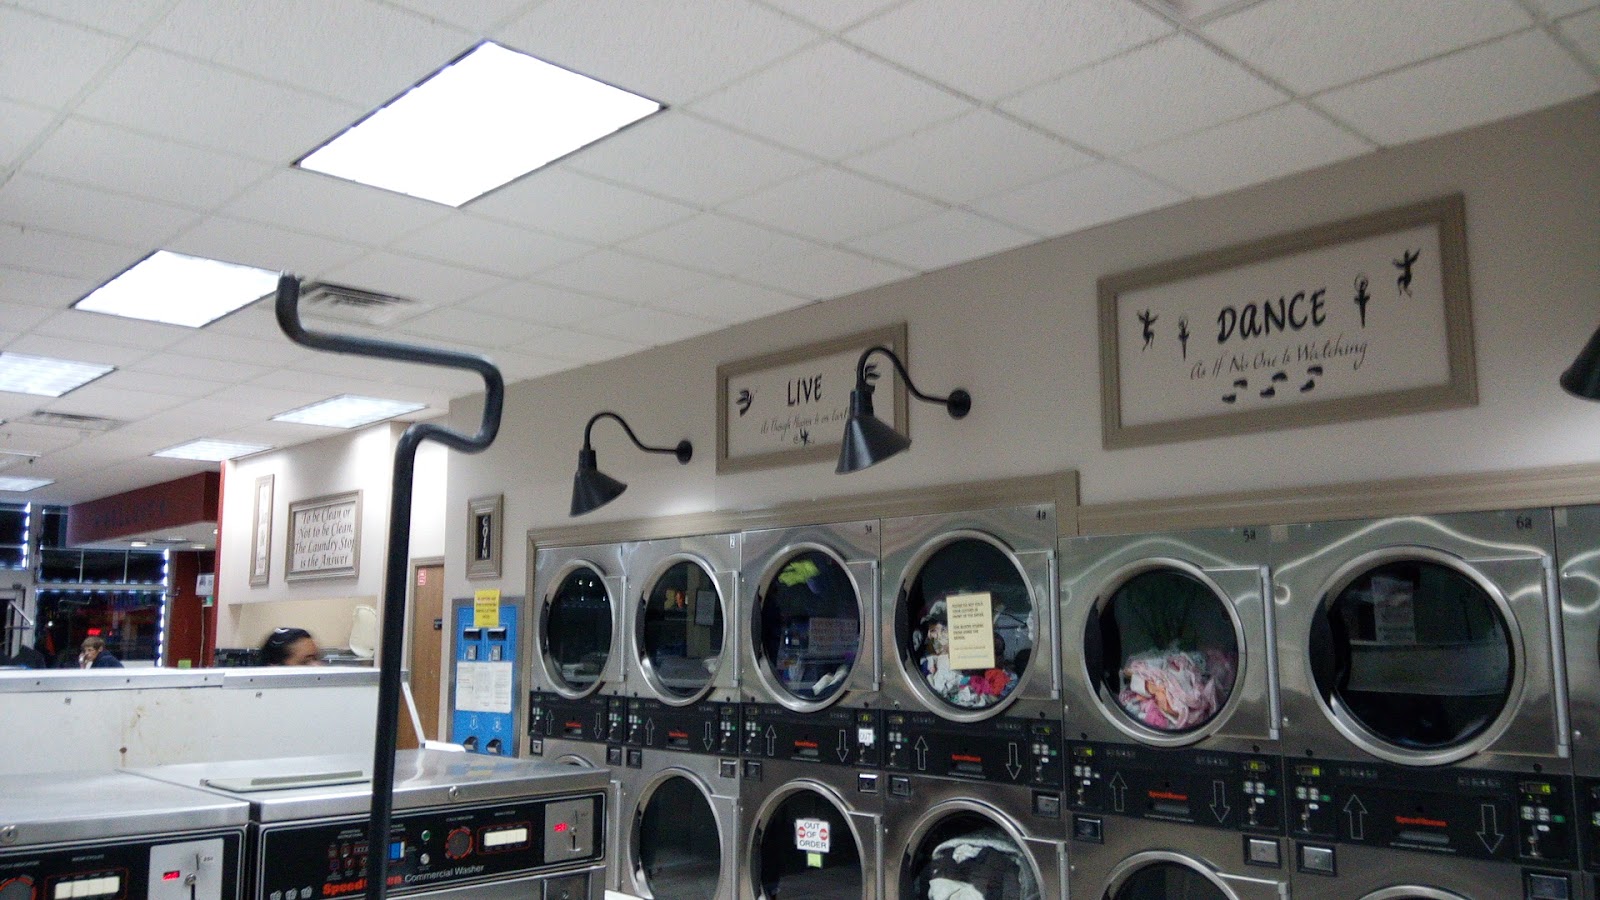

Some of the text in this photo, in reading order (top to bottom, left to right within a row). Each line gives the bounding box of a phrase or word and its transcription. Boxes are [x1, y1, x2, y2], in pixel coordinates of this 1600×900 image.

[1191, 361, 1206, 379] As
[1213, 352, 1228, 378] If
[1229, 352, 1249, 372] No
[1254, 351, 1277, 369] One
[1298, 334, 1368, 370] Watching
[787, 373, 823, 407] LIVE
[302, 506, 351, 524] To be Clean or
[299, 528, 311, 539] Not
[313, 526, 320, 538] to
[322, 523, 329, 536] be
[295, 543, 306, 554] The
[308, 537, 337, 554] Laundry
[308, 554, 319, 567] the
[320, 553, 348, 568] Answer
[804, 821, 820, 829] OUT
[799, 840, 827, 849] ORDER
[404, 868, 453, 882] Commercial
[455, 865, 484, 875] Washer
